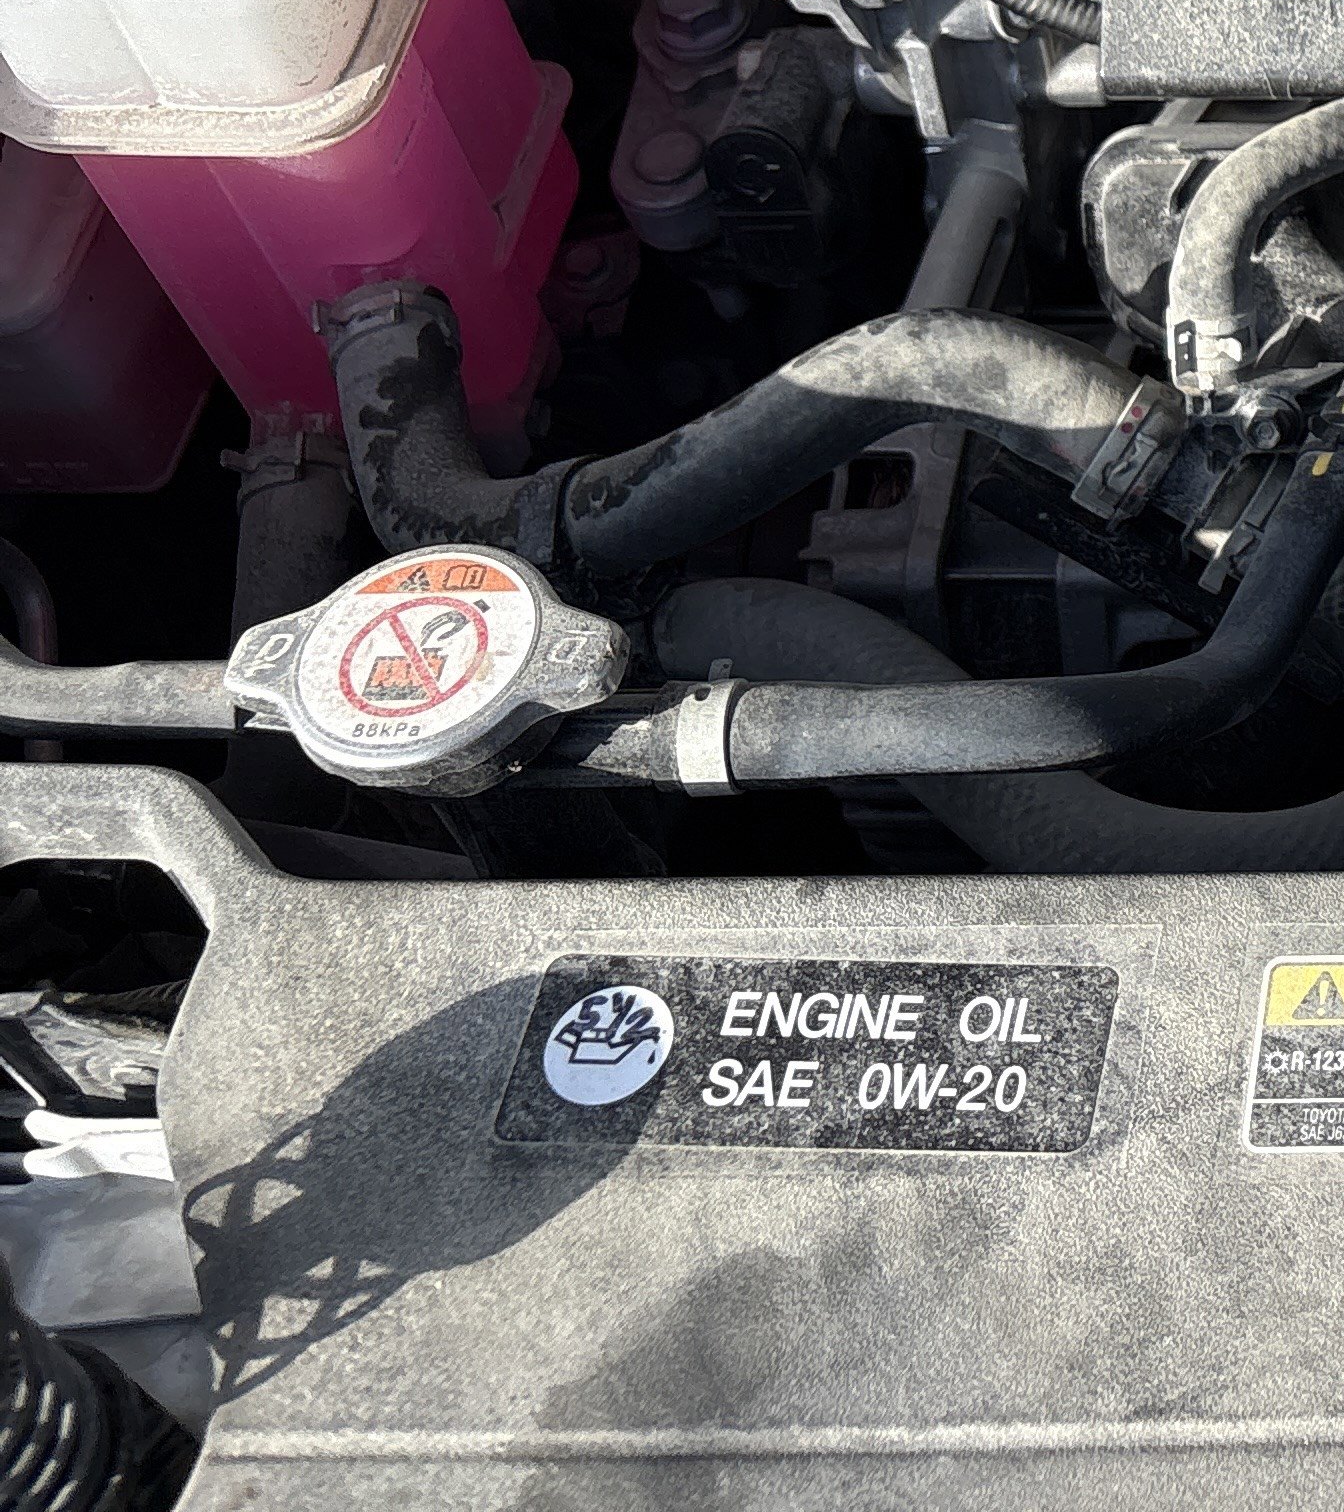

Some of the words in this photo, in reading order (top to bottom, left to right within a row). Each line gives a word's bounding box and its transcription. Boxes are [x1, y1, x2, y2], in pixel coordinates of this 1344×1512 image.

[351, 722, 422, 739] 88kPa
[719, 991, 925, 1042] ENGINE
[958, 996, 1043, 1044] OIL
[702, 1059, 819, 1108] SAE
[858, 1063, 1027, 1112] 0W-20
[1300, 1124, 1325, 1141] SAE
